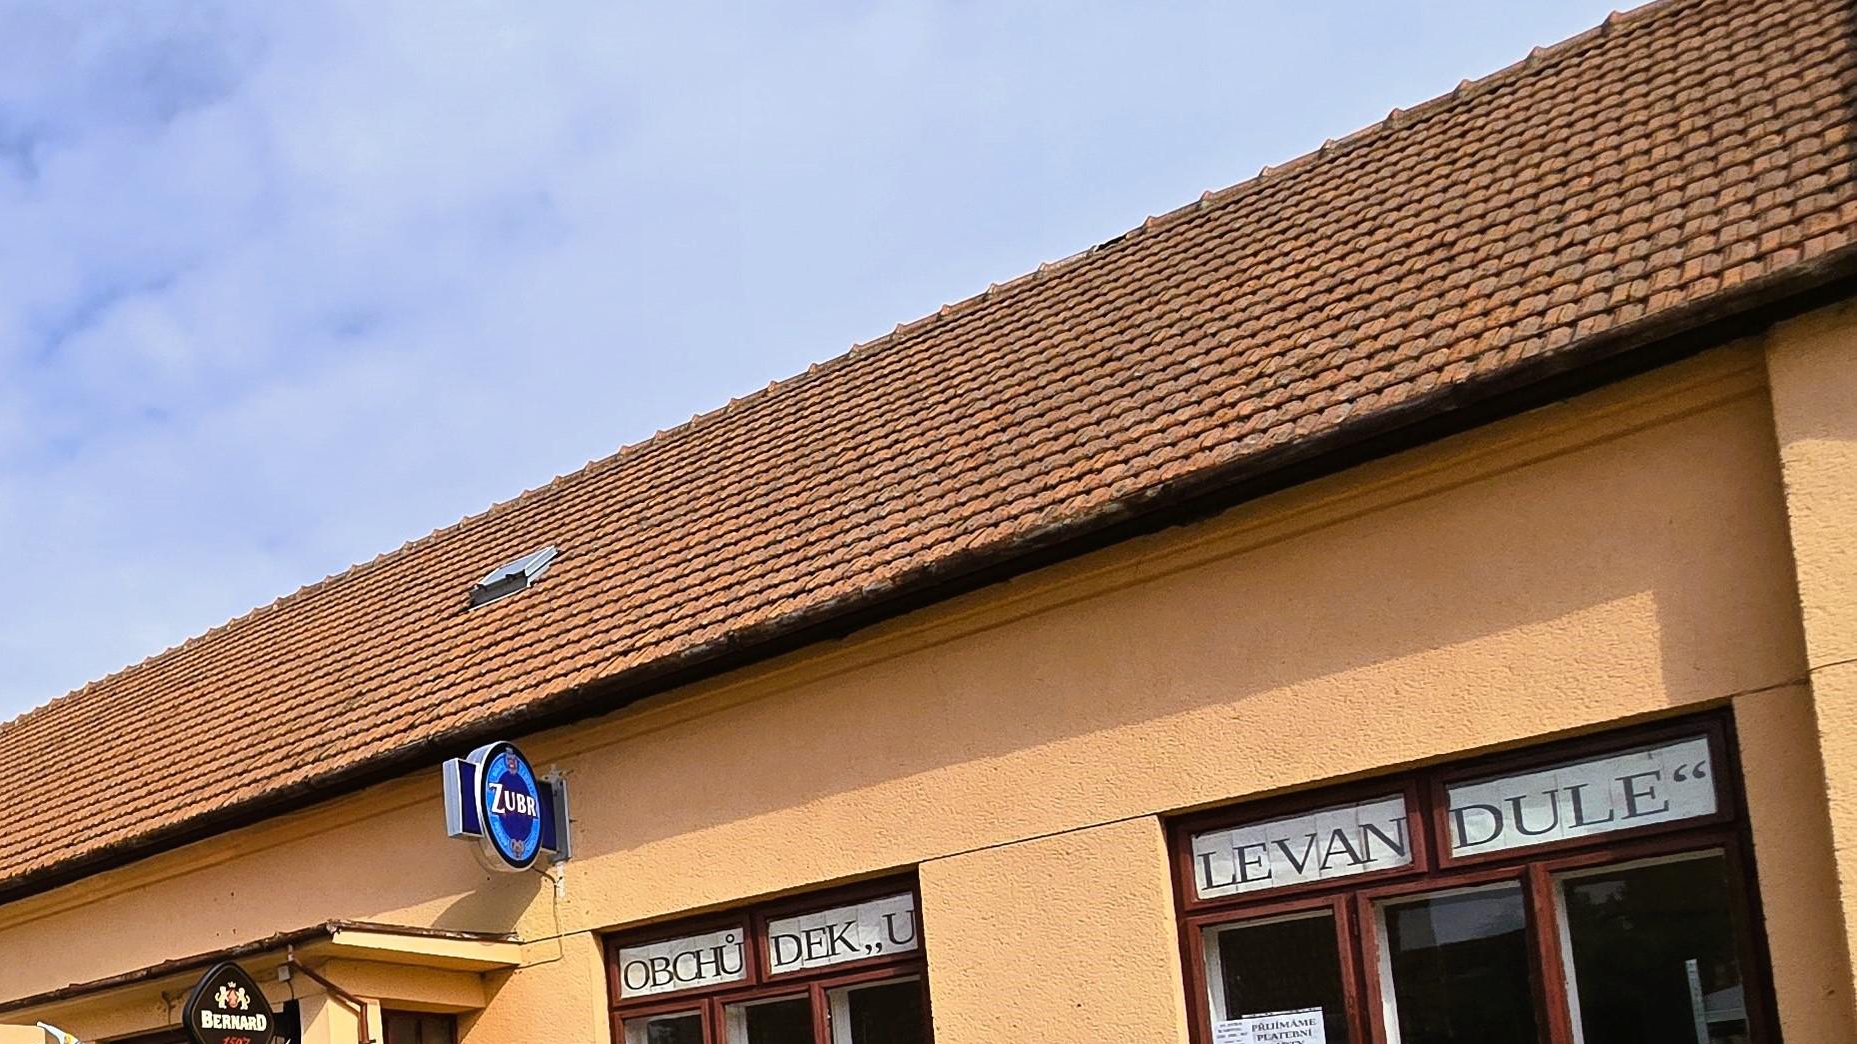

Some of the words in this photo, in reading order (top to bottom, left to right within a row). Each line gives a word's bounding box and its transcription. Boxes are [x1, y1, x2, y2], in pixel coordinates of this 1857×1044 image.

[488, 782, 537, 817] ZUBR
[1198, 816, 1410, 891] LEVAN
[623, 933, 745, 991] OBCHŮ
[201, 1009, 268, 1032] BERNARD
[1256, 1029, 1313, 1042] PLATEBNÍ
